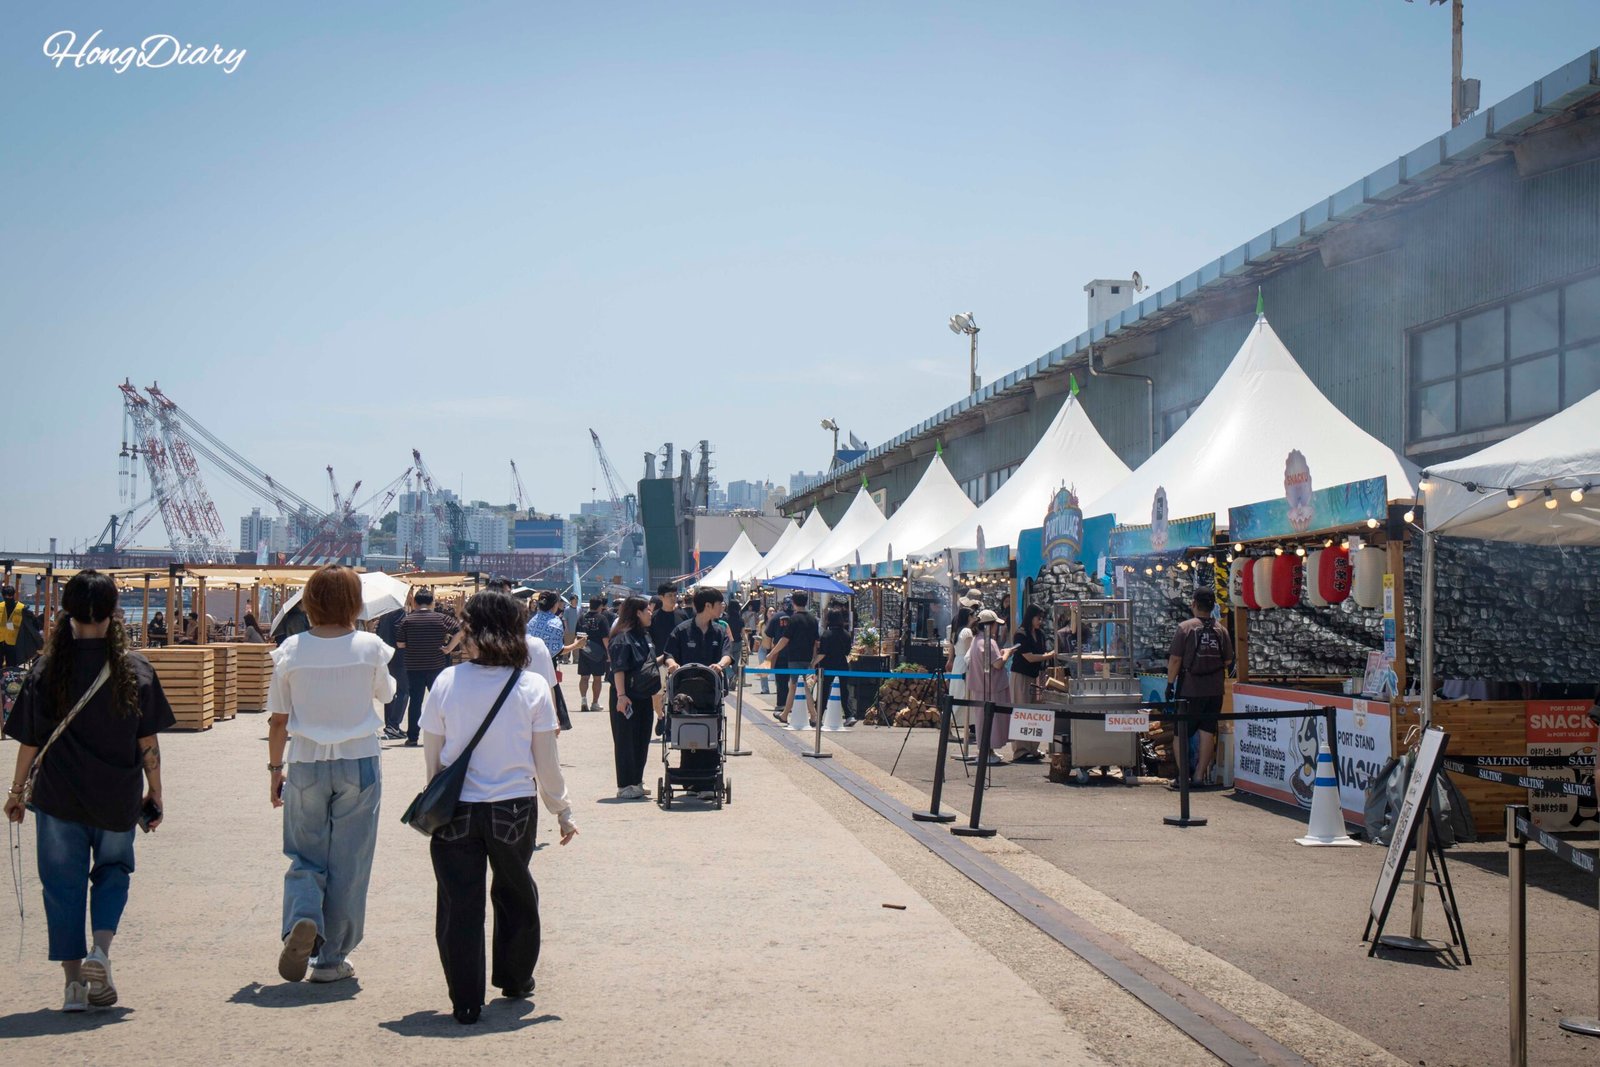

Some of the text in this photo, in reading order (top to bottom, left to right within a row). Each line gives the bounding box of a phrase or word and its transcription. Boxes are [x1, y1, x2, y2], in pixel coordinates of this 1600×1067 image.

[1013, 711, 1052, 722] SNACKU
[1108, 717, 1146, 725] SNACKU
[1020, 727, 1043, 737] 대기줄
[1337, 730, 1375, 751] PORT STAND
[1240, 739, 1286, 762] Seafood Yakisoba
[1530, 747, 1561, 756] 야끼소바
[1477, 756, 1597, 766] SALTING SALT
[1443, 760, 1592, 797] SALTING SALTING SALTING SALTING
[1572, 848, 1594, 872] SALTING
